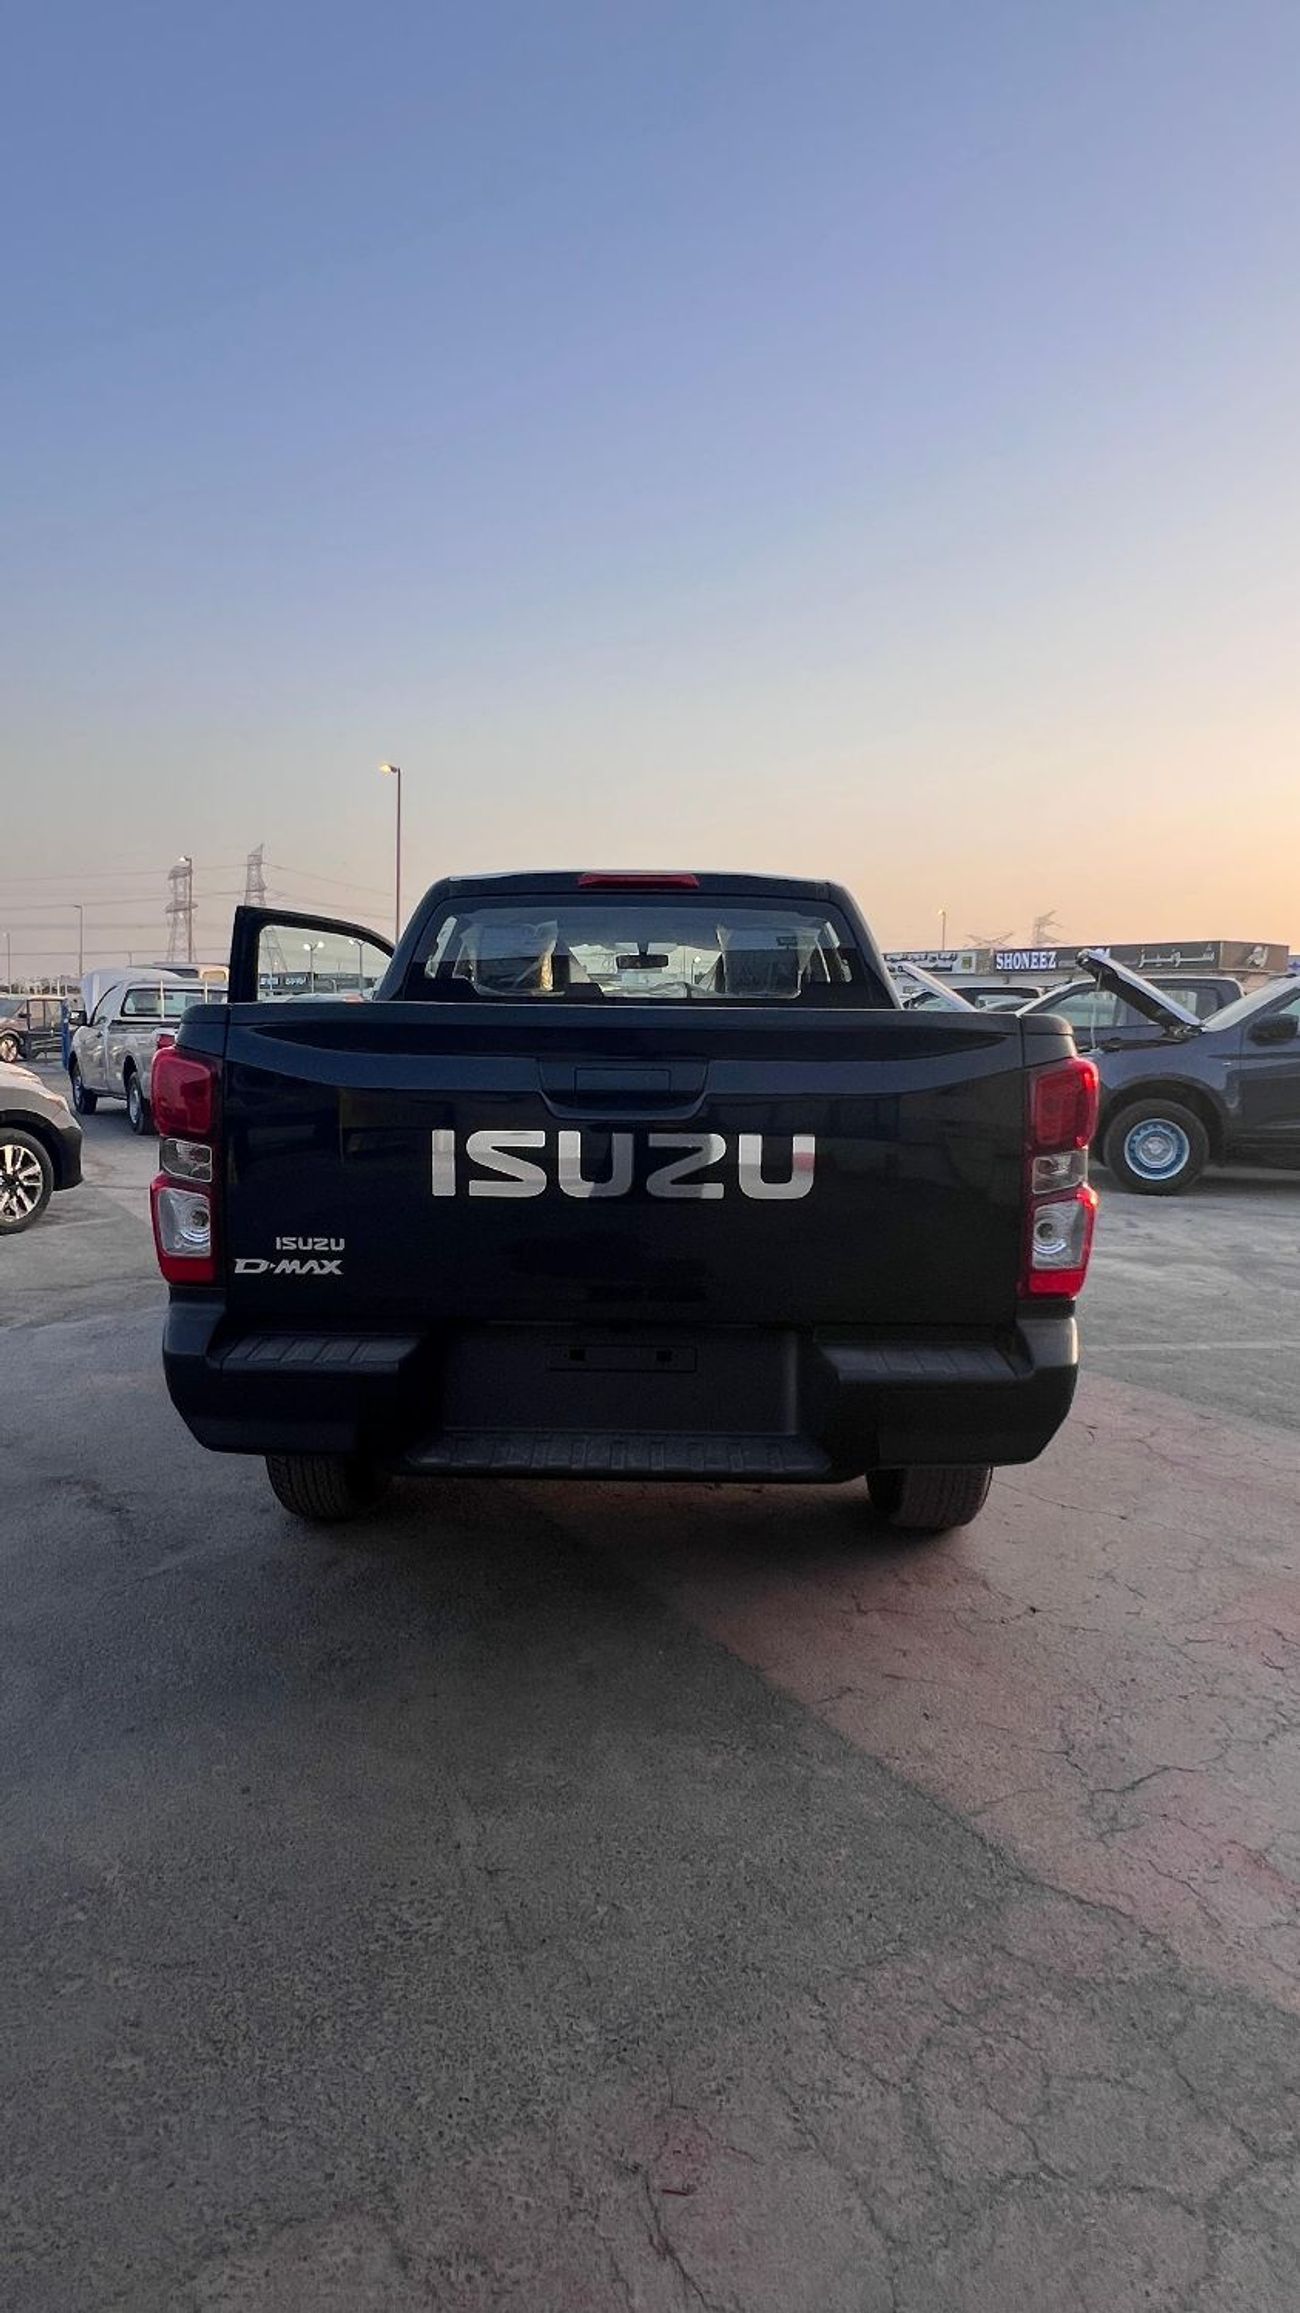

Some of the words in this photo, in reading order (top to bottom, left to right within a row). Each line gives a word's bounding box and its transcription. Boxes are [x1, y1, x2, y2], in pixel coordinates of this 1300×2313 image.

[996, 951, 1057, 970] SHONEEZ
[430, 1129, 816, 1200] ISUZU
[275, 1236, 346, 1252] ISUZU
[234, 1258, 344, 1275] D-MAX
